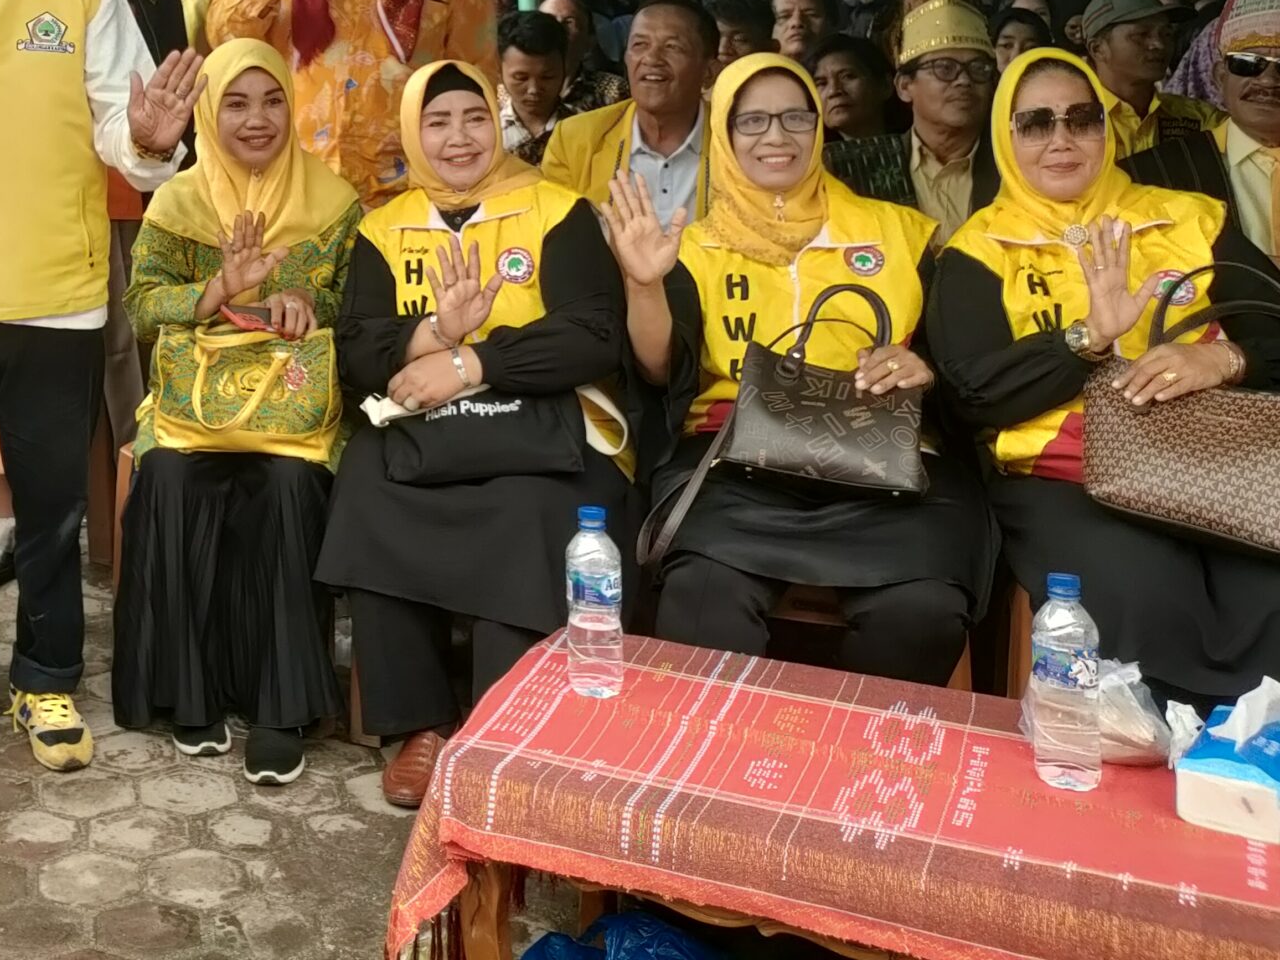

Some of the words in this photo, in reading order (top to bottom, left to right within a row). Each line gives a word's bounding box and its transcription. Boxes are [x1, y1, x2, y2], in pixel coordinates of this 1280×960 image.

[405, 258, 423, 286] H
[1027, 273, 1050, 297] H
[725, 273, 749, 301] H
[722, 312, 756, 342] W
